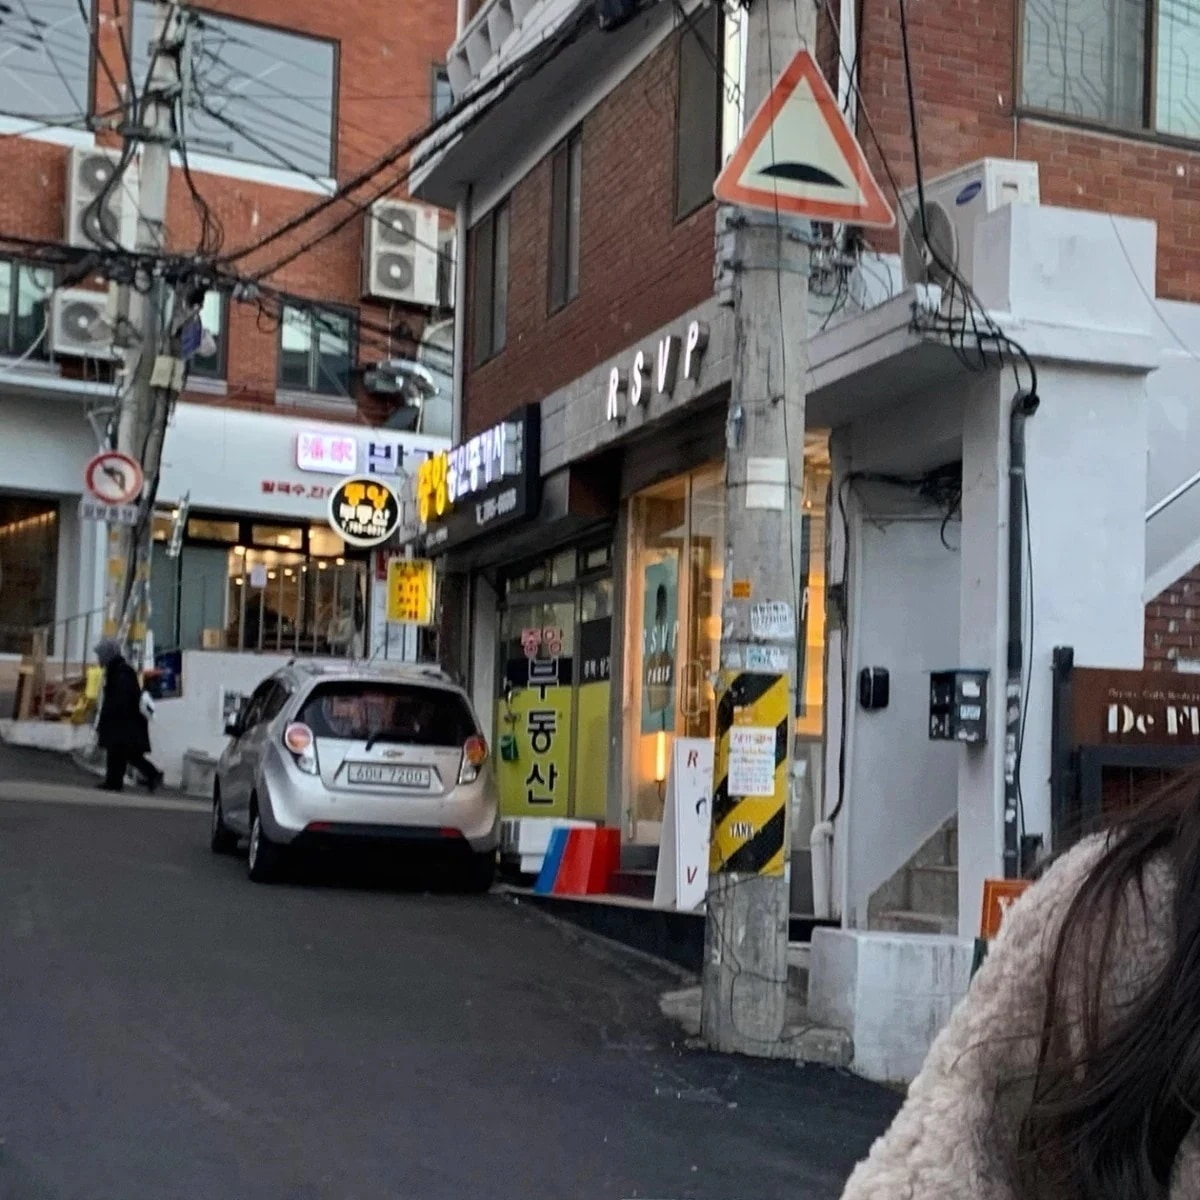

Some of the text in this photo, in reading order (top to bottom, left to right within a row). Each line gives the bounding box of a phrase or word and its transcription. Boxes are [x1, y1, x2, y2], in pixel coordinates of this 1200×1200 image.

[607, 320, 699, 421] RSVP
[525, 657, 559, 805] 부동산
[1107, 704, 1154, 734] De
